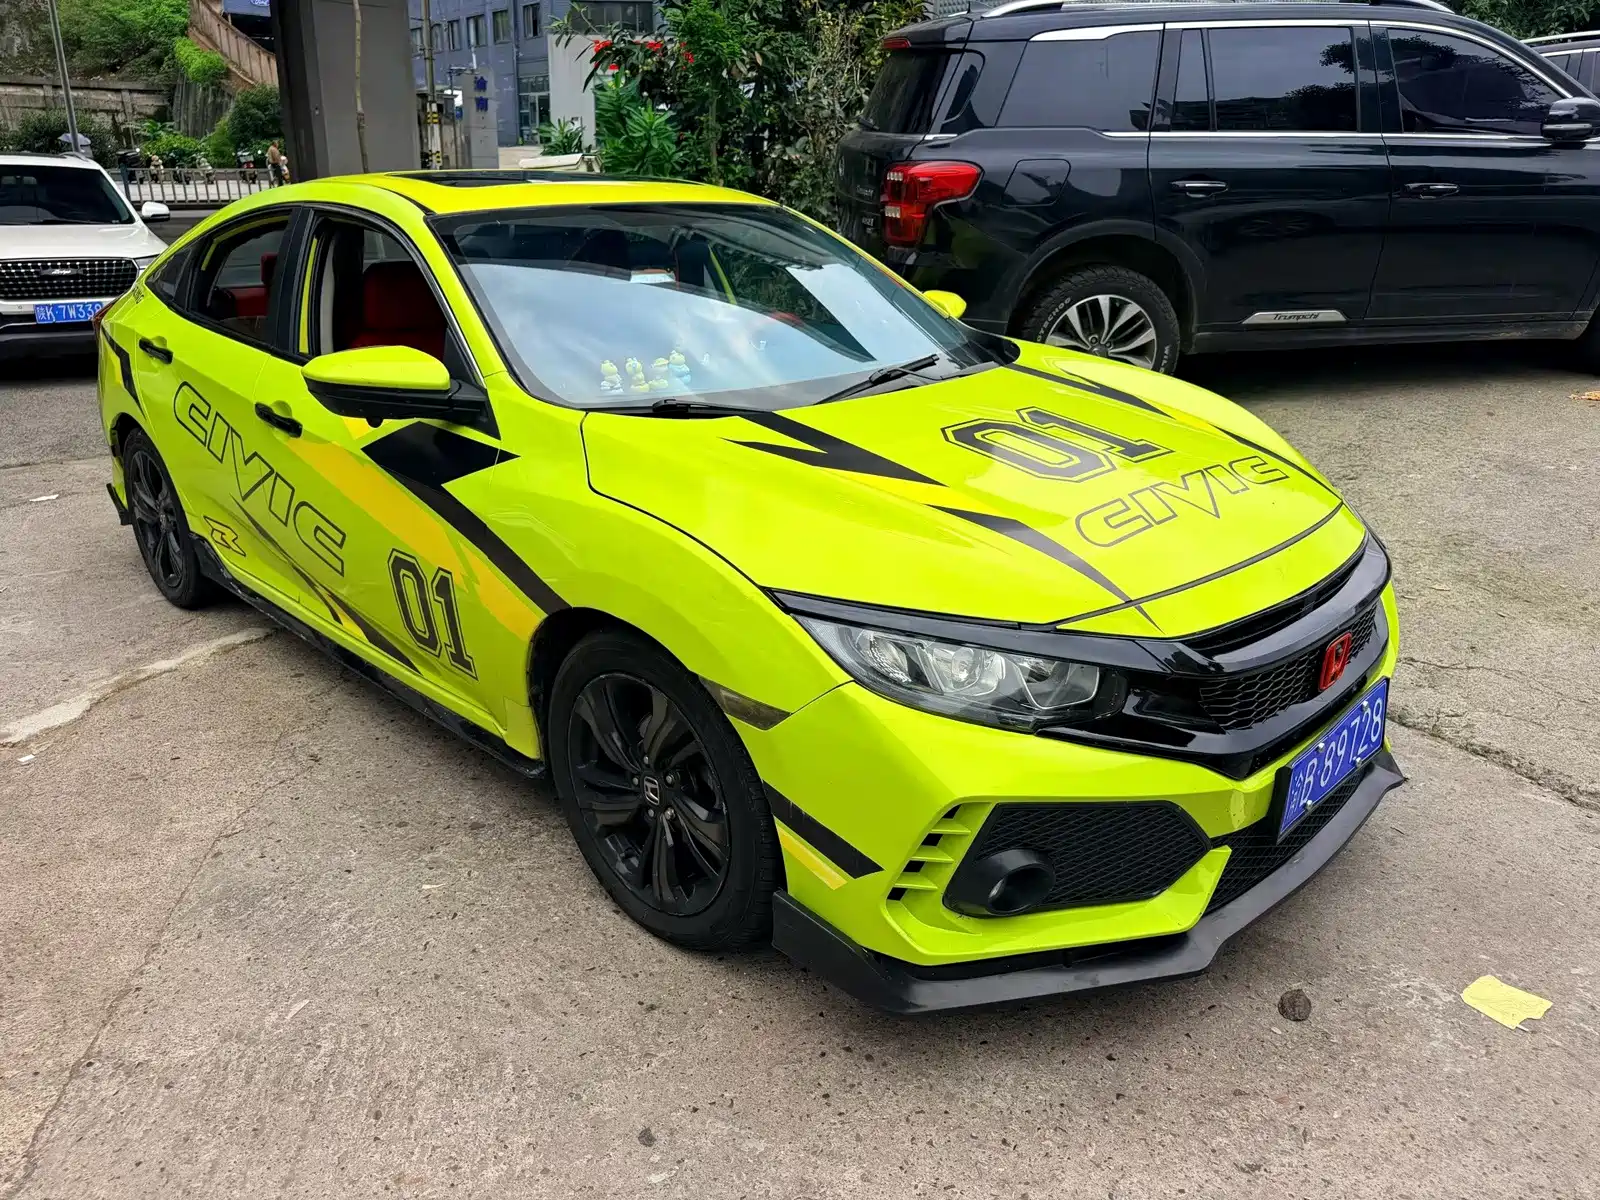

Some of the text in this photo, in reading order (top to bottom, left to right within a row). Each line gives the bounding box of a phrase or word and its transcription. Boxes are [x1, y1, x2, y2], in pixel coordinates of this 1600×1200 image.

[1273, 312, 1320, 323] Trumpchi
[173, 380, 347, 577] CIVIC
[940, 406, 1175, 484] 01
[1074, 455, 1290, 548] CIVIC
[387, 548, 478, 681] 01
